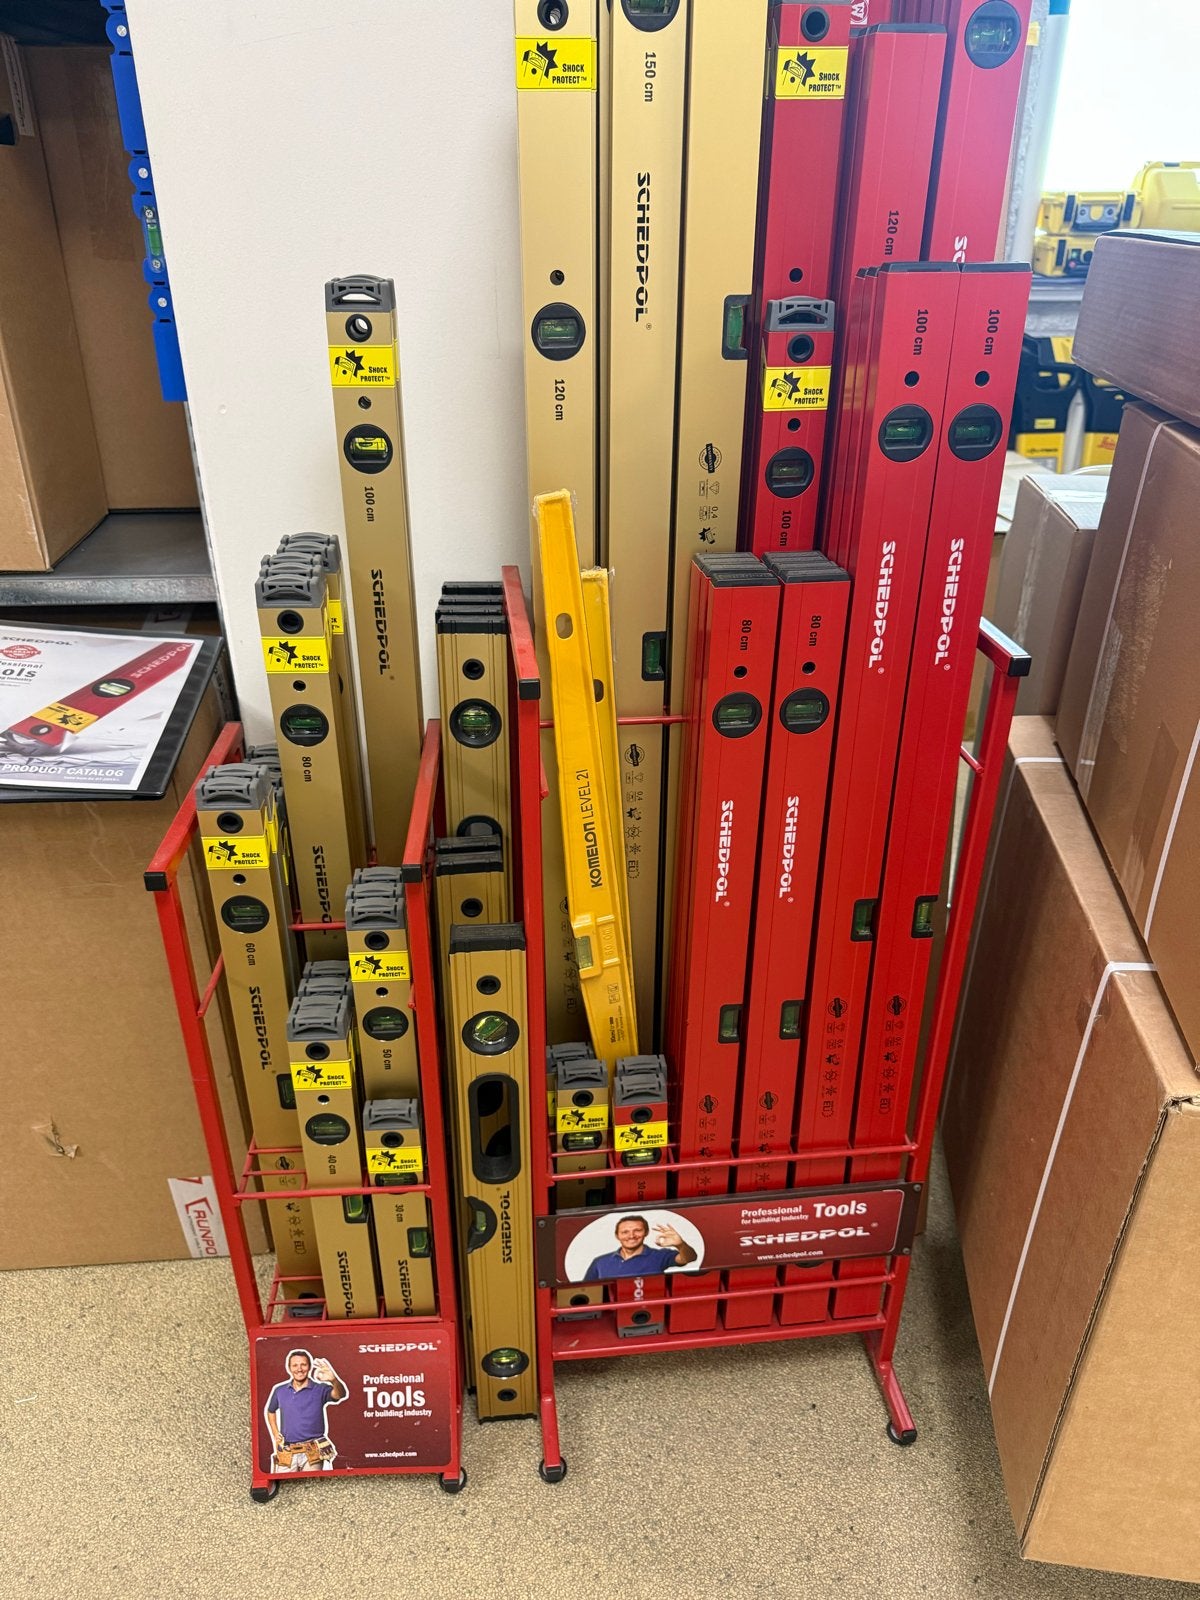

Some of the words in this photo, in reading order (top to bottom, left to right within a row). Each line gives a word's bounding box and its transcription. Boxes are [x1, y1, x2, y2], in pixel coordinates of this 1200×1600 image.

[562, 64, 585, 73] SHOCK
[644, 51, 657, 79] 150
[818, 72, 840, 82] SHOCK
[644, 83, 654, 102] cm
[888, 210, 900, 234] 120
[884, 237, 894, 256] cm
[916, 308, 929, 334] 100
[988, 308, 1000, 334] 100
[913, 336, 923, 356] cm
[984, 336, 994, 356] cm
[368, 366, 388, 374] SHOCK
[554, 378, 566, 402] 120
[803, 387, 824, 396] SHOCK
[554, 404, 564, 421] cm
[364, 486, 376, 506] 100
[366, 507, 375, 522] cm
[780, 510, 792, 530] 100
[779, 530, 786, 547] cm
[742, 619, 752, 634] 80
[810, 615, 822, 630] 80
[740, 636, 748, 652] cm
[808, 631, 817, 647] cm
[2, 764, 65, 774] PRODUCT
[66, 767, 125, 777] CATALOG
[302, 756, 312, 770] 80
[304, 770, 312, 782] cm
[578, 780, 595, 819] LEVEL
[584, 821, 602, 888] KOMELON
[245, 942, 256, 955] 60
[248, 956, 256, 966] cm
[382, 1049, 392, 1060] 50
[384, 1060, 392, 1070] cm
[328, 1154, 337, 1165] 40
[329, 1166, 336, 1175] cm
[638, 1181, 646, 1190] 30
[394, 1204, 404, 1212] 30
[741, 1204, 803, 1218] Professional
[813, 1200, 868, 1219] Tools
[396, 1213, 404, 1222] cm
[752, 1216, 780, 1225] building
[781, 1213, 809, 1222] industry
[757, 1250, 824, 1261] www.schedpol.com
[363, 1372, 424, 1385] Professional
[363, 1386, 426, 1408] Tools
[364, 1410, 374, 1418] for
[375, 1409, 404, 1418] building
[404, 1408, 432, 1418] industry
